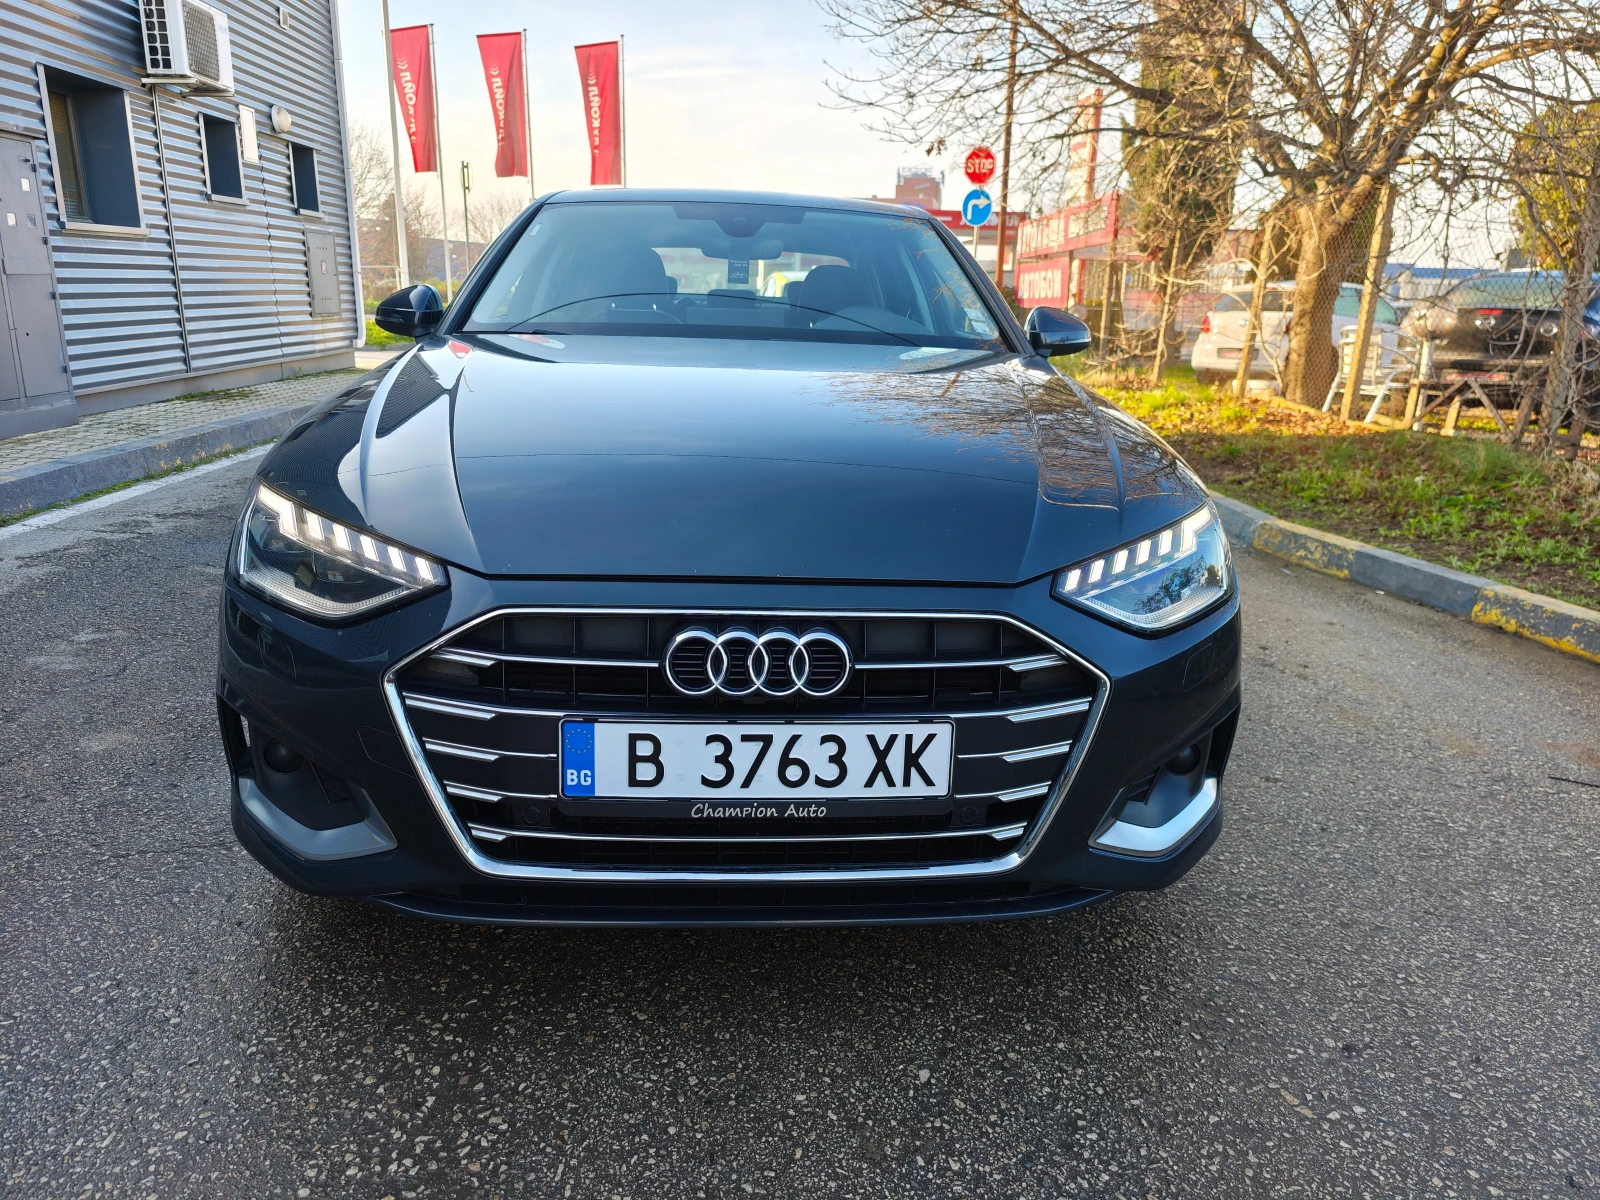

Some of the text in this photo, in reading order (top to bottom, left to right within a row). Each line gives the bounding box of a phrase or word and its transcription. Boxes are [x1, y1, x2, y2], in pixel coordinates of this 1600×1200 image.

[967, 158, 994, 174] STOP
[628, 733, 938, 789] B 3763 XK
[566, 769, 592, 786] BG
[691, 802, 827, 818] Champion Auto
